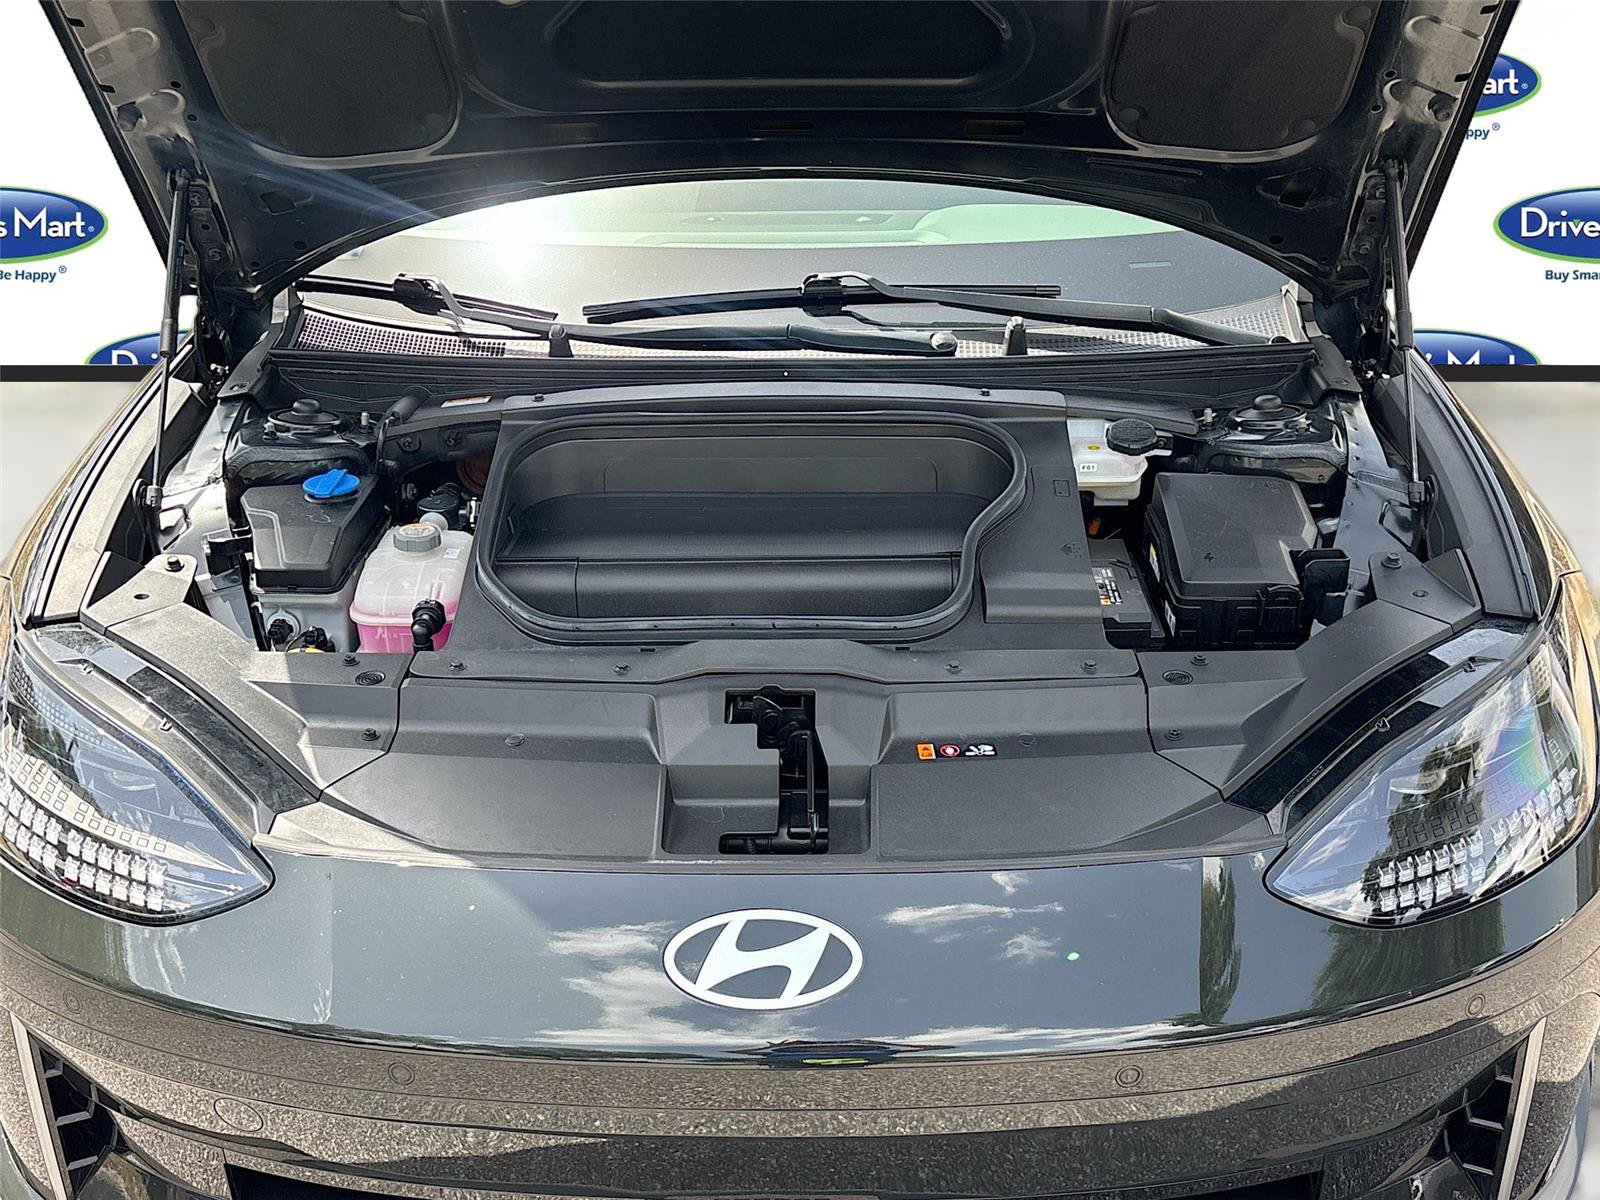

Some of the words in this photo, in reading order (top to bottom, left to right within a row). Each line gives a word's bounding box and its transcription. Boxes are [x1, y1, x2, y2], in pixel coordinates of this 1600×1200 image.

[1482, 68, 1519, 95] art
[1465, 128, 1491, 141] ppy
[13, 205, 86, 238] Mart
[15, 269, 58, 284] Happy
[1544, 269, 1570, 284] Buy
